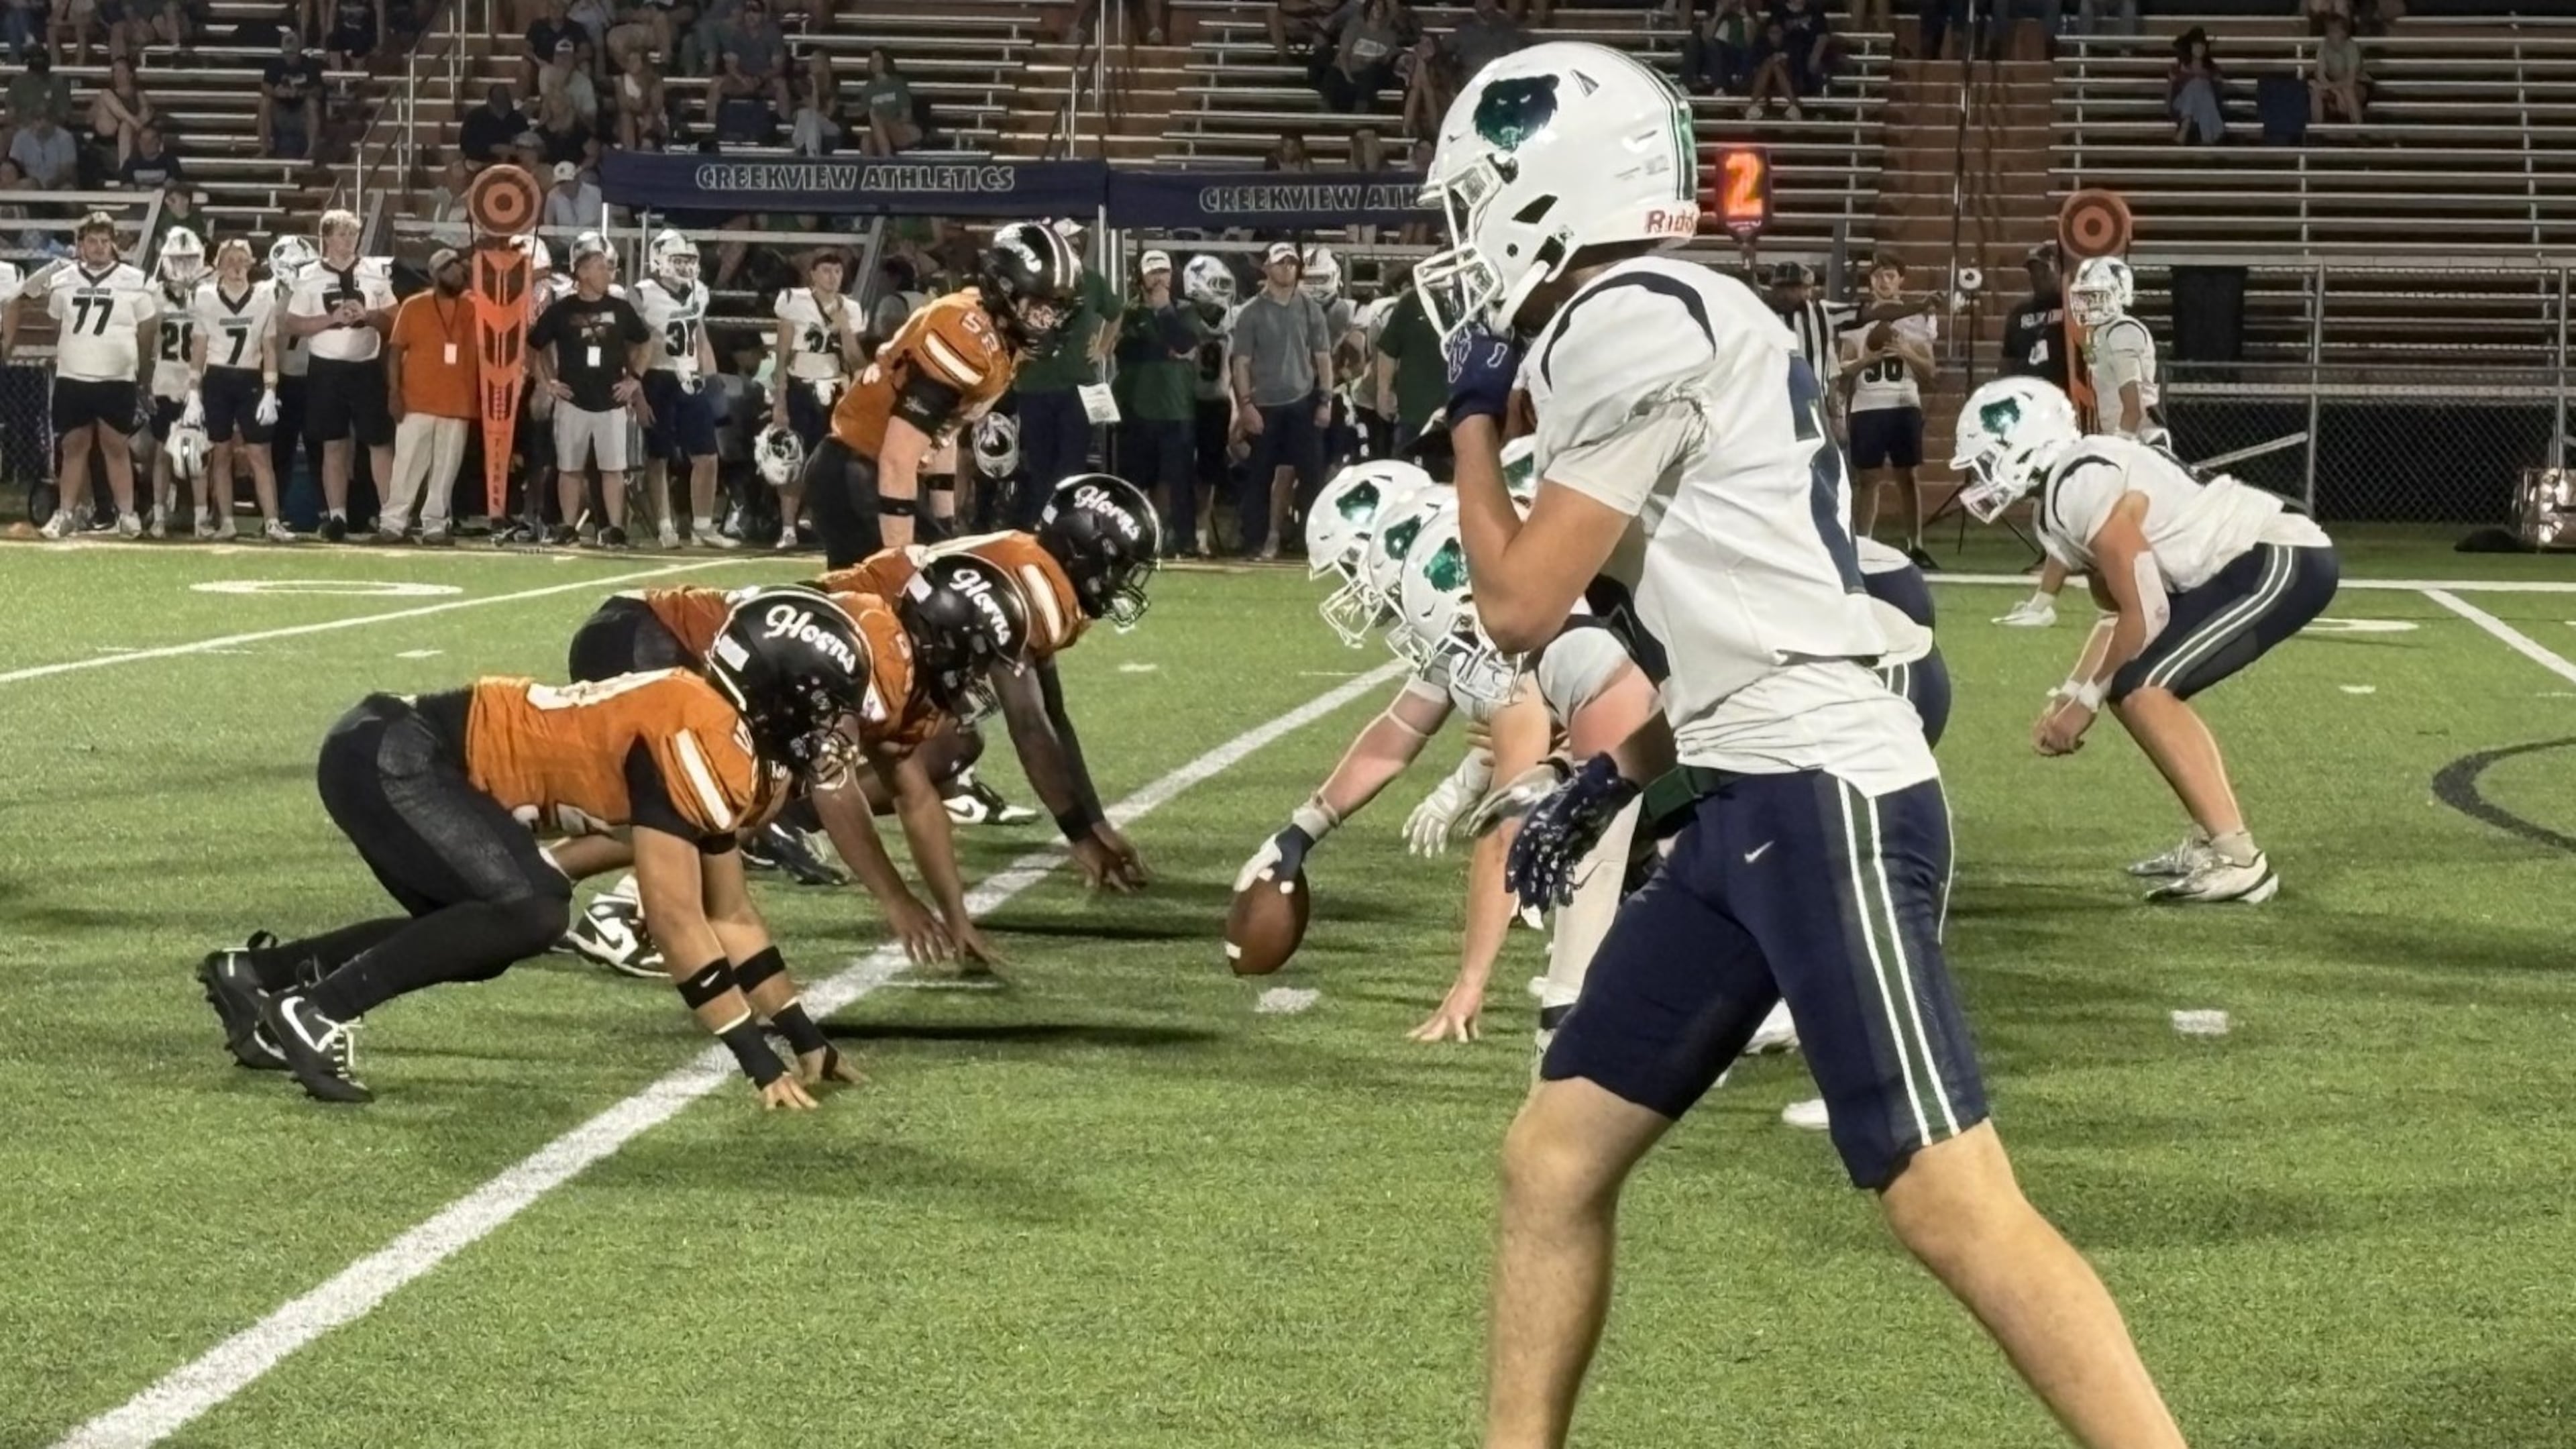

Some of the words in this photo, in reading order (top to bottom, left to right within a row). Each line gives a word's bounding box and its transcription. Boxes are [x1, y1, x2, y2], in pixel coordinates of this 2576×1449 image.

[695, 164, 857, 191] CREEKVIEW
[861, 166, 1014, 191] ATHLETICS
[1199, 184, 1361, 213] CREEKVIEW
[1364, 184, 1425, 210] ATH
[1725, 152, 1764, 215] 2
[72, 297, 115, 335] 77
[225, 327, 248, 365] 7
[1073, 485, 1141, 541] Horns
[948, 568, 1011, 646] Horns
[762, 604, 856, 674] Horns
